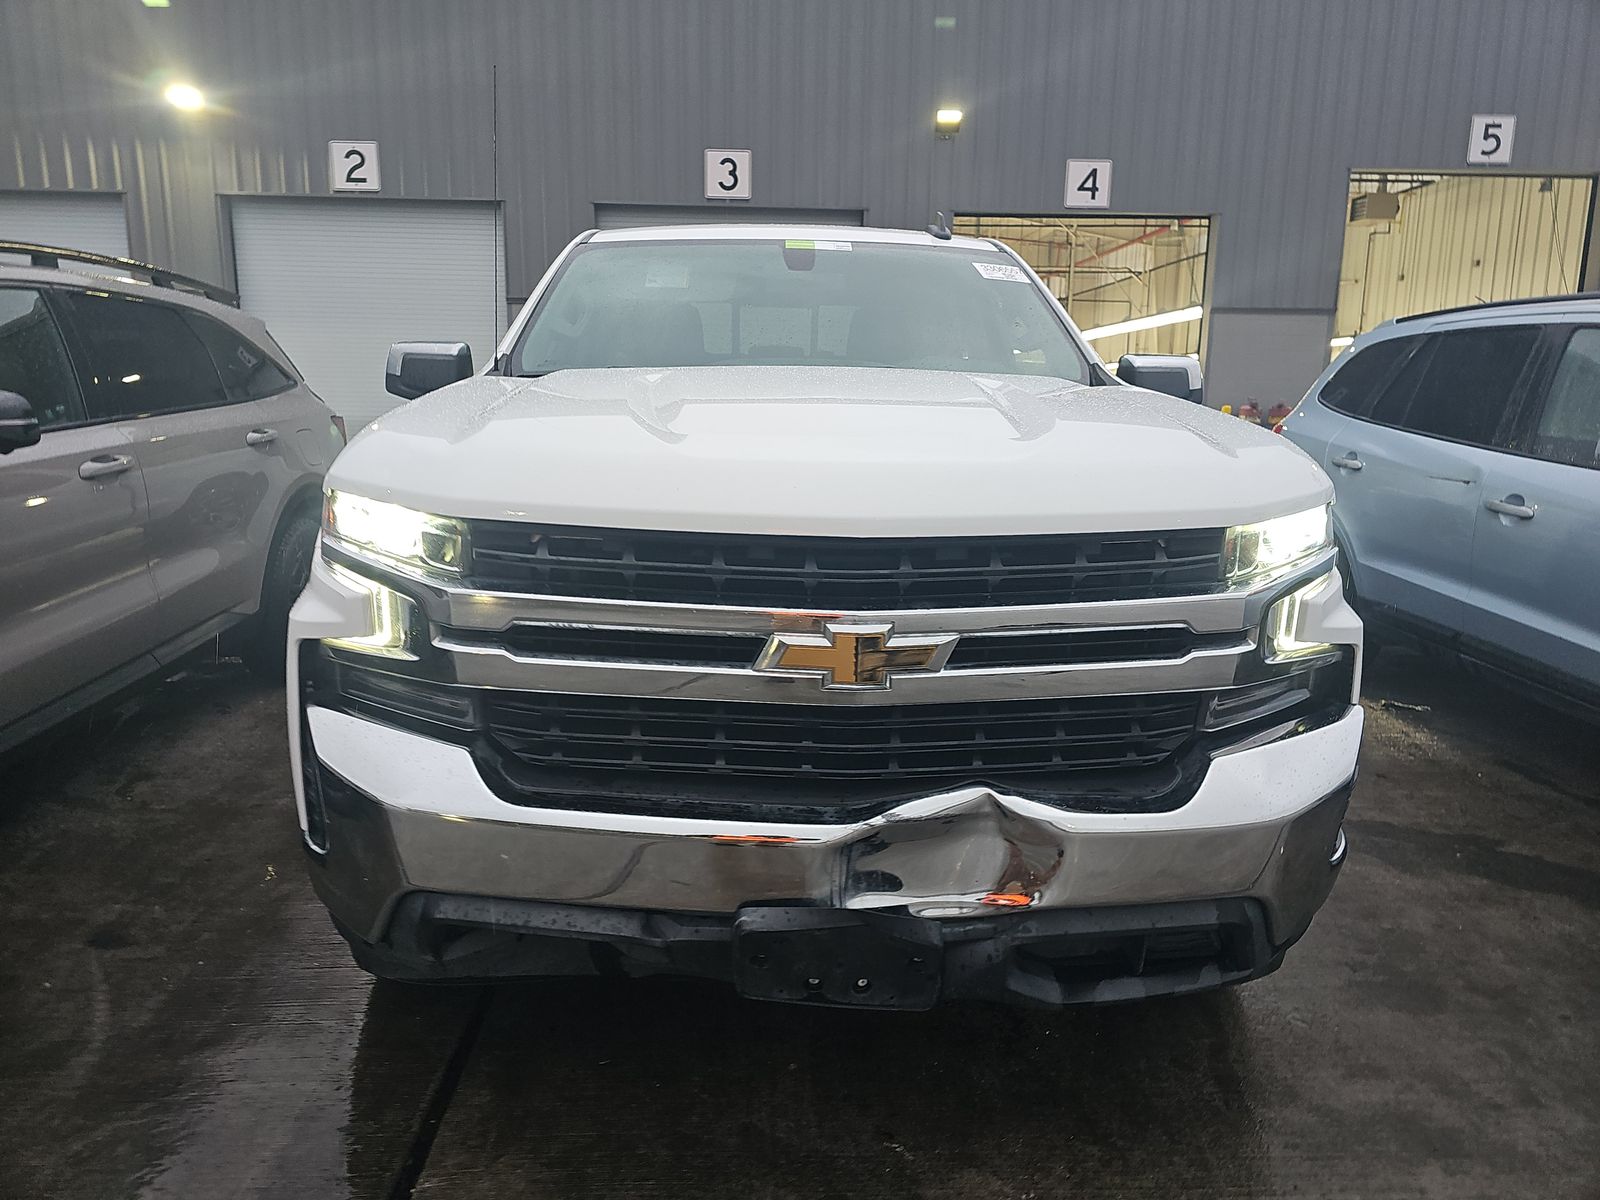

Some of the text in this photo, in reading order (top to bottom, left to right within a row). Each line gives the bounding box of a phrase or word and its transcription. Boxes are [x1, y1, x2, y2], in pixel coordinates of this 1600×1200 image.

[1481, 123, 1502, 155] 5
[344, 149, 367, 183] 2
[718, 157, 738, 191] 3
[1077, 168, 1099, 200] 4
